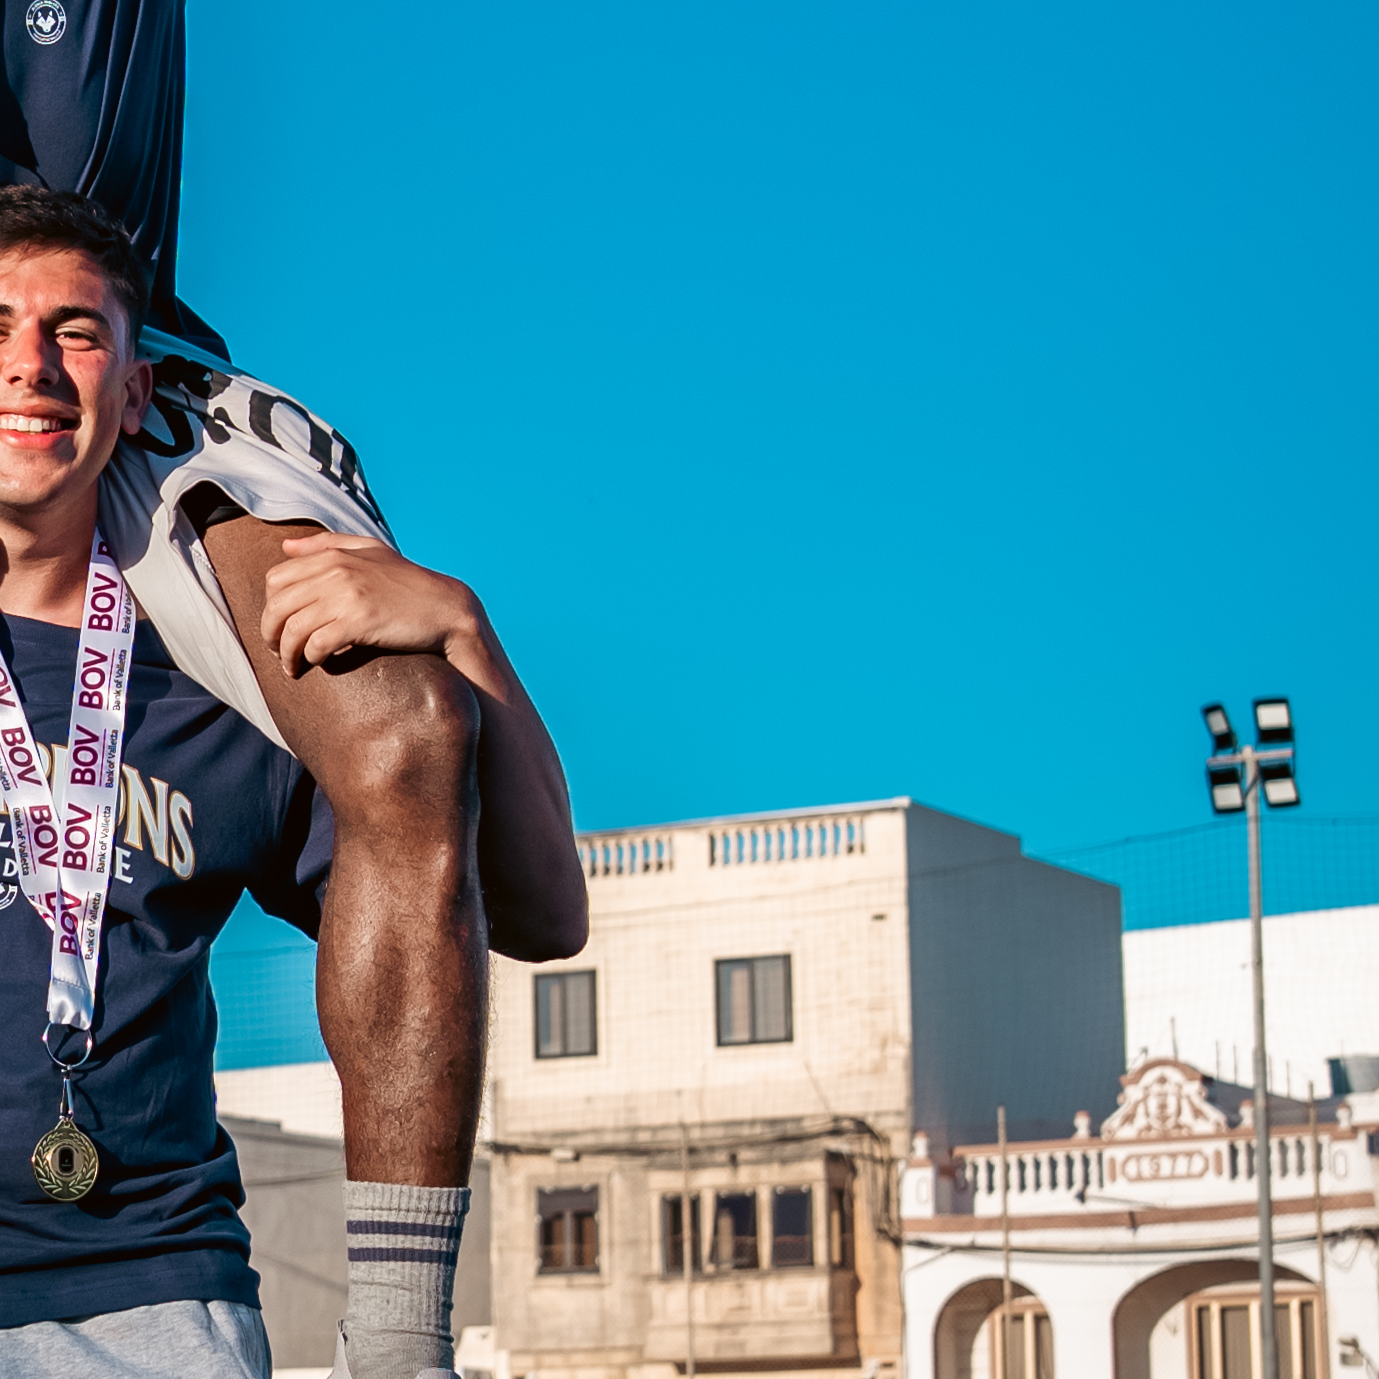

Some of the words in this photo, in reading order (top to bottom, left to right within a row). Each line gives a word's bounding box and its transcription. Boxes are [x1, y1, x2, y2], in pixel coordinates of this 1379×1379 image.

[88, 572, 118, 631] BOV
[79, 646, 108, 710] BOV
[115, 678, 123, 693] of
[1, 726, 42, 787] BOV
[70, 723, 100, 786] BOV
[109, 729, 119, 757] Valletta
[105, 771, 114, 789] Bank
[108, 758, 116, 771] of
[17, 829, 25, 842] of
[29, 804, 58, 868] BOV
[62, 802, 92, 871] BOV
[100, 805, 111, 837] Valletta
[18, 841, 30, 876] Valletta
[99, 837, 108, 851] of
[96, 852, 105, 874] Bank
[59, 888, 82, 957] BOV
[88, 892, 101, 923] Valletta
[87, 923, 96, 939] of
[84, 940, 93, 961] Bank
